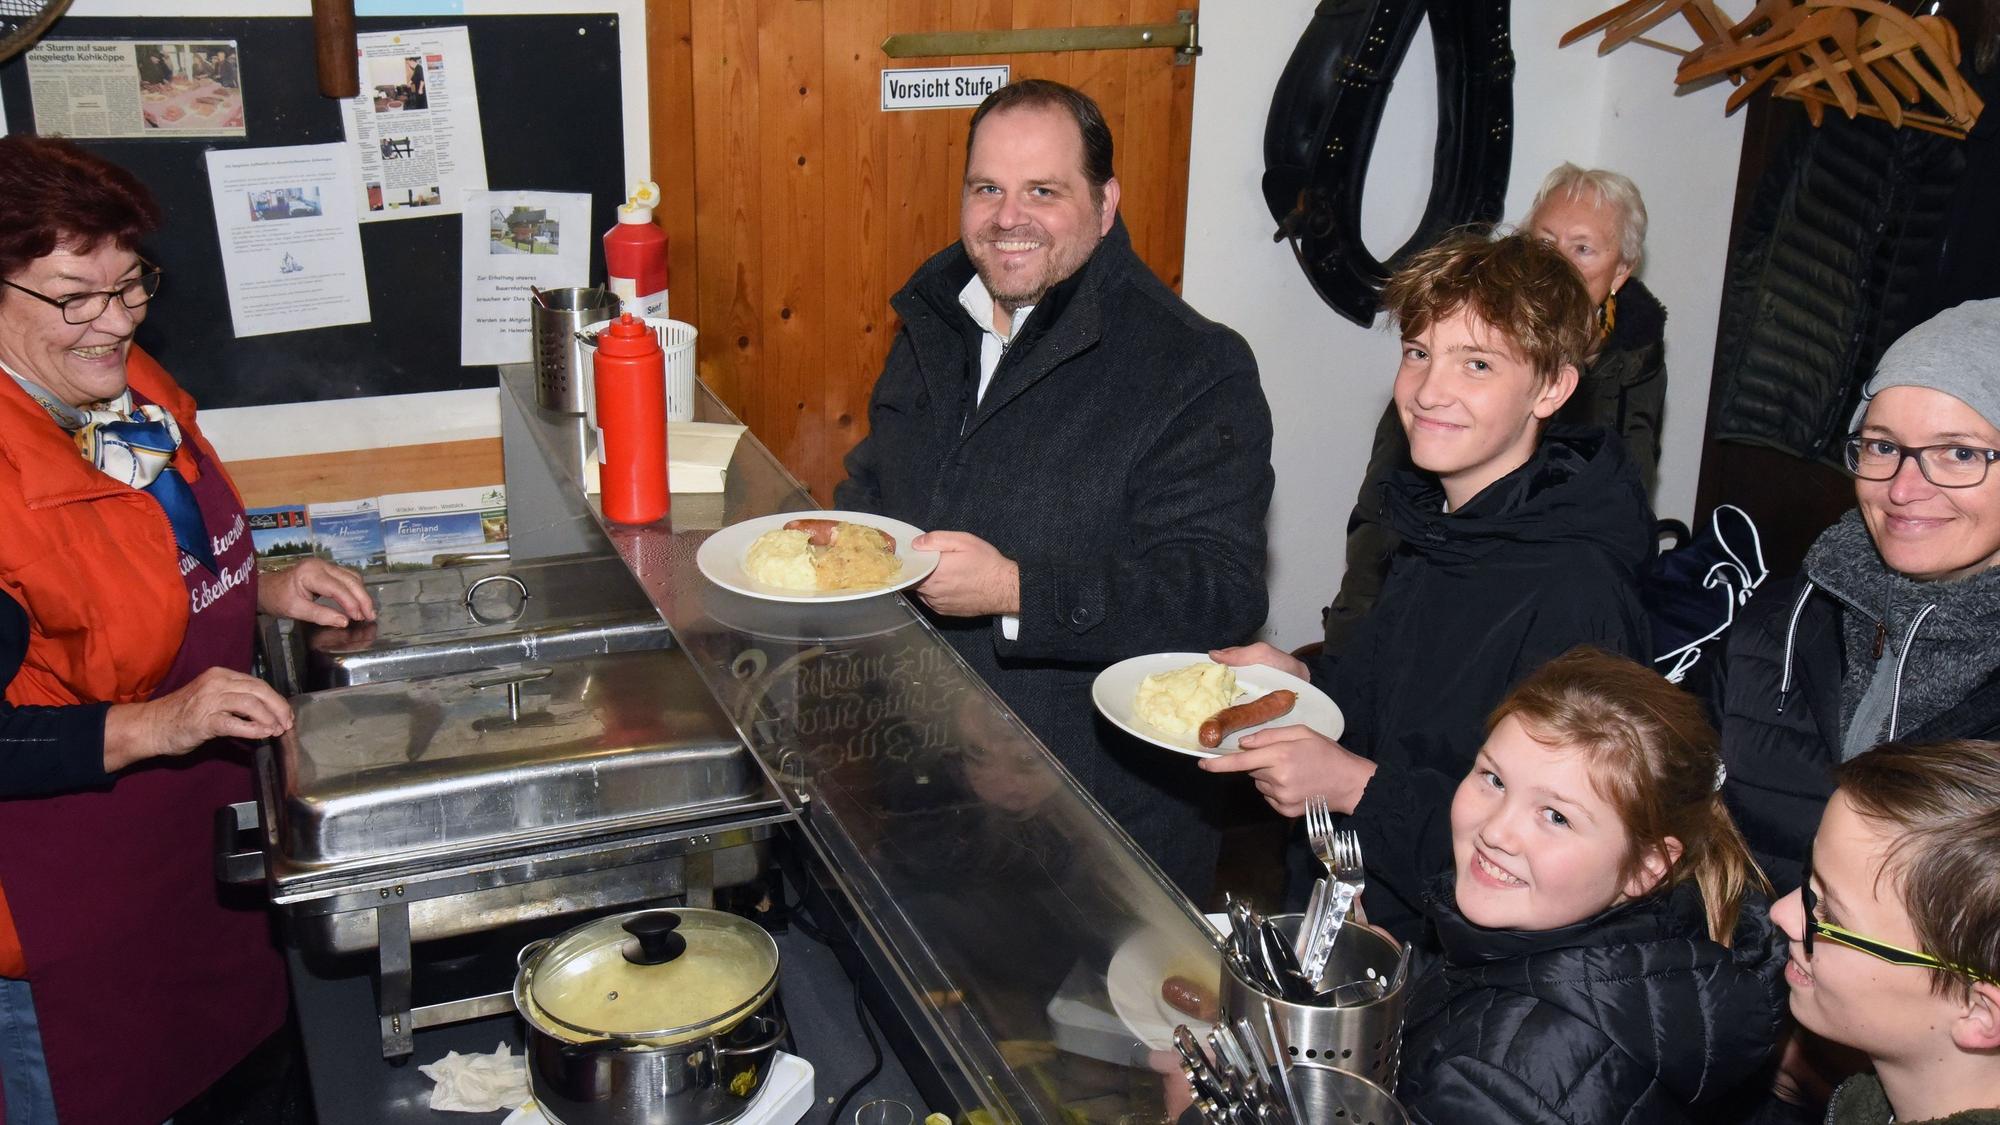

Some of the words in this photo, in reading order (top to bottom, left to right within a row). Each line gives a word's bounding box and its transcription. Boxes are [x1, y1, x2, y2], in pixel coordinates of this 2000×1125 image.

[46, 43, 74, 51] Sturm
[76, 43, 90, 51] auf
[28, 53, 75, 63] eingelegte
[77, 53, 125, 63] Kohlköppe
[889, 78, 950, 99] Vorsicht
[955, 76, 992, 97] Stufe
[646, 302, 662, 315] Senf
[398, 520, 439, 535] Ferienland
[192, 552, 255, 613] Eckenhagen
